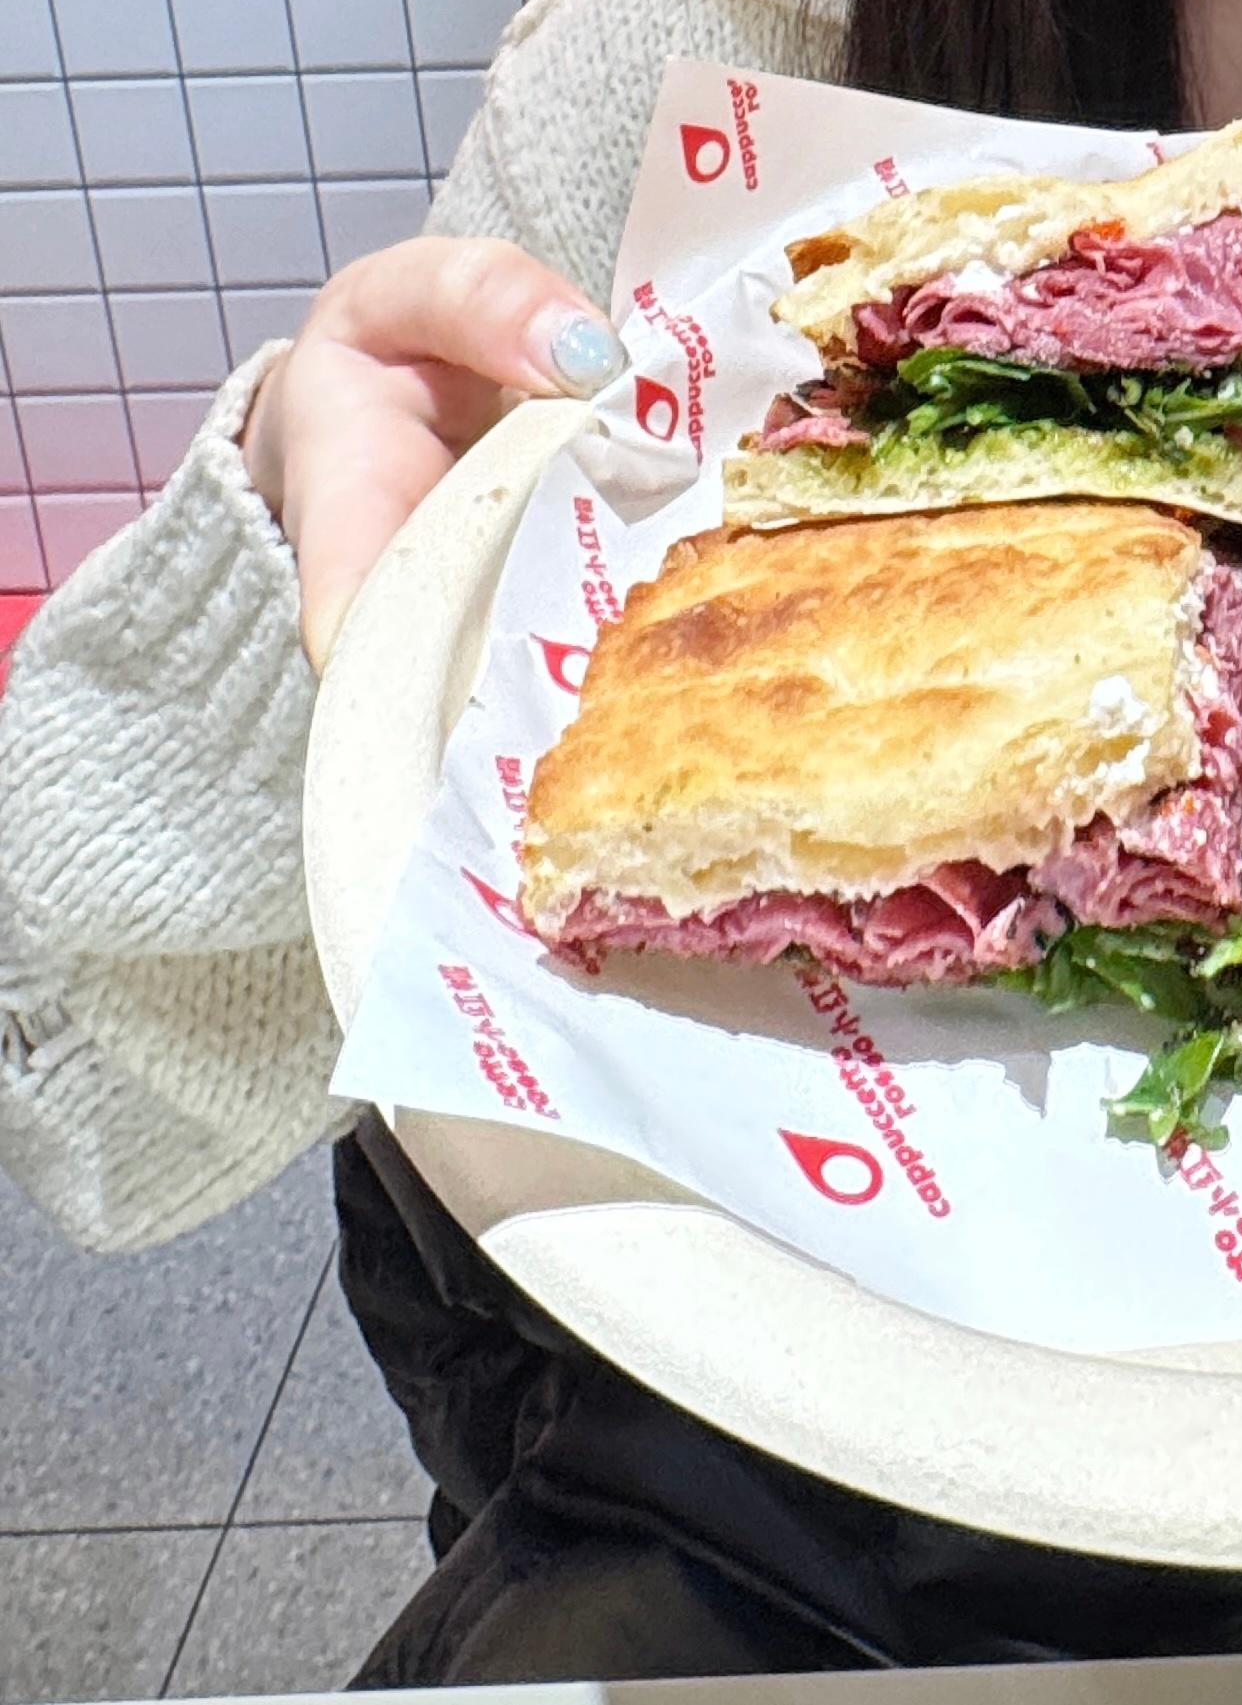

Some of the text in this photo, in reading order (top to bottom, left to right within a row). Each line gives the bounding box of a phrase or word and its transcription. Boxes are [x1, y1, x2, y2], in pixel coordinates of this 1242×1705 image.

[726, 77, 760, 191] cappucce
[742, 81, 760, 116] ro
[848, 1033, 913, 1118] rosso
[832, 1043, 950, 1218] cappuccetto
